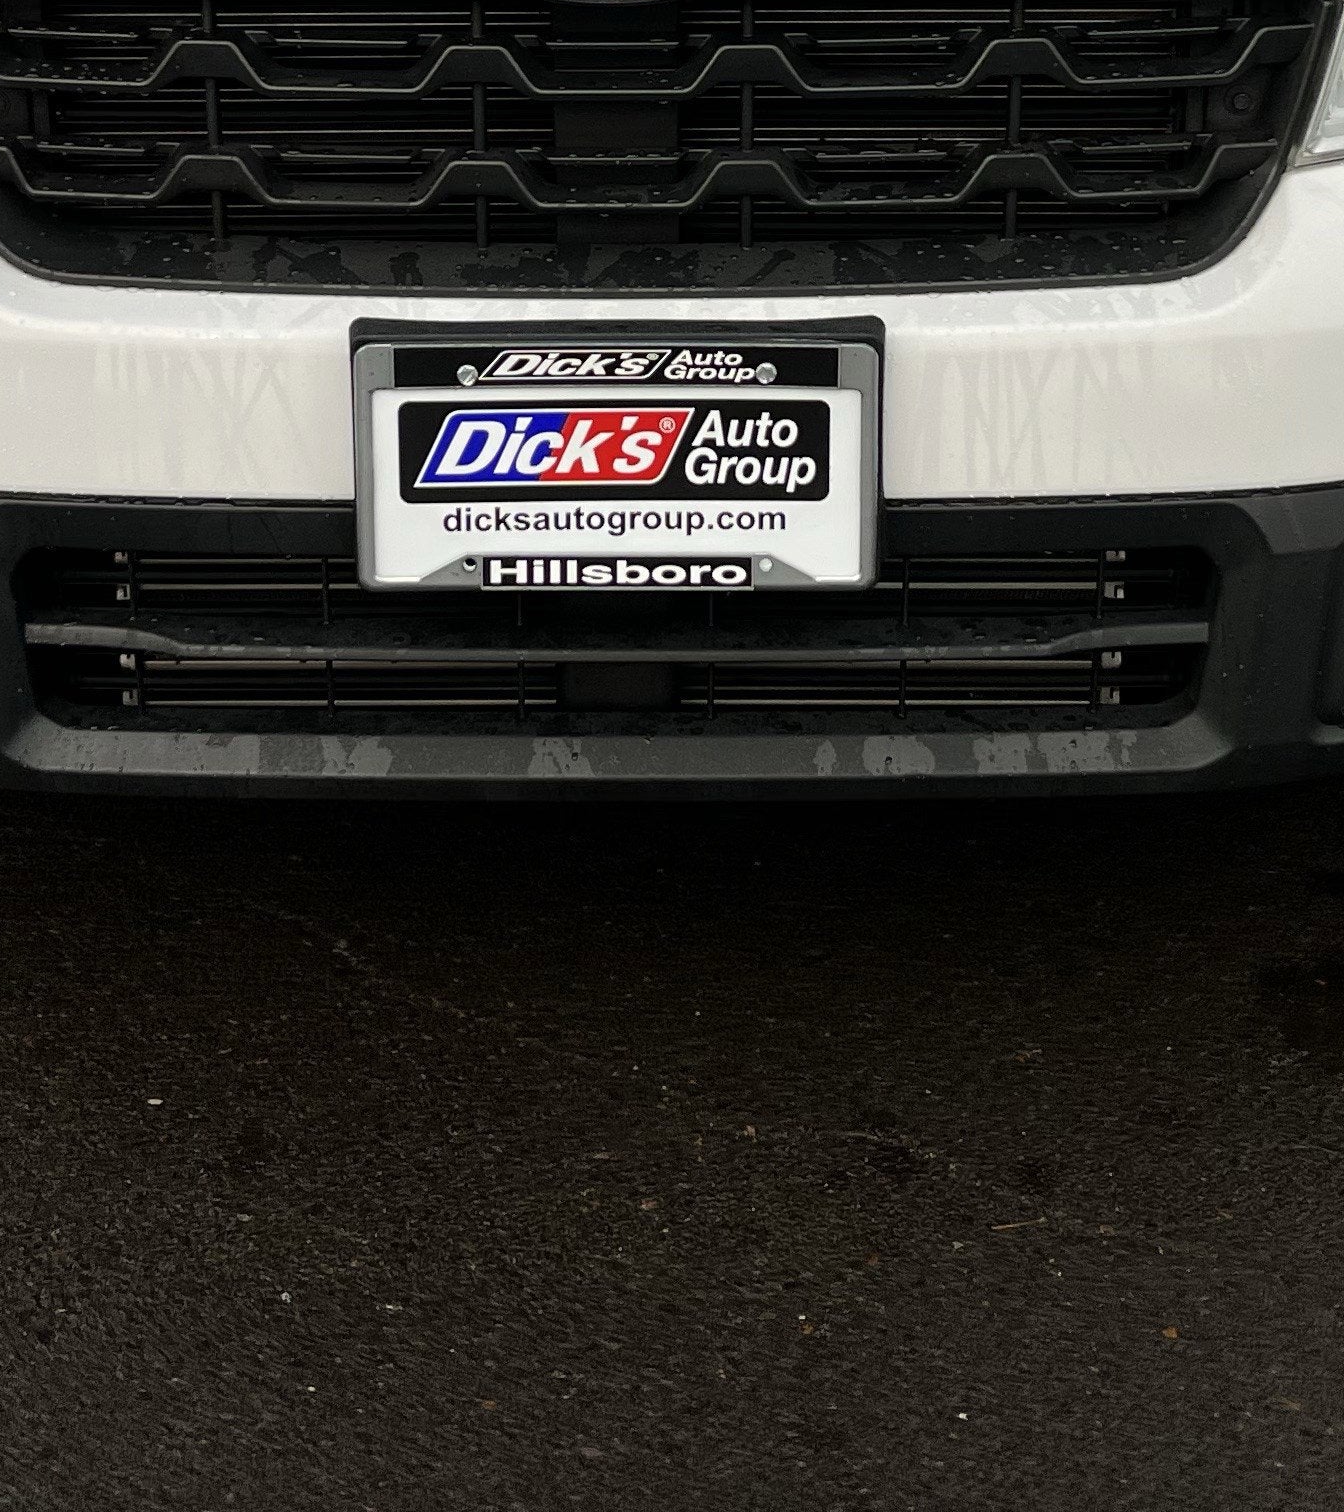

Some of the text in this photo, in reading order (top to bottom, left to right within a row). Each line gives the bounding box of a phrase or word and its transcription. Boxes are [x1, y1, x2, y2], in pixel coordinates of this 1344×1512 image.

[492, 352, 650, 377] Dick's
[670, 349, 743, 366] Auto
[663, 364, 756, 383] Group
[692, 409, 799, 448] Auto
[435, 415, 662, 476] Dick's
[685, 446, 817, 493] Group
[443, 506, 787, 536] dicksautogroup.com
[488, 558, 748, 585] Hillsboro
